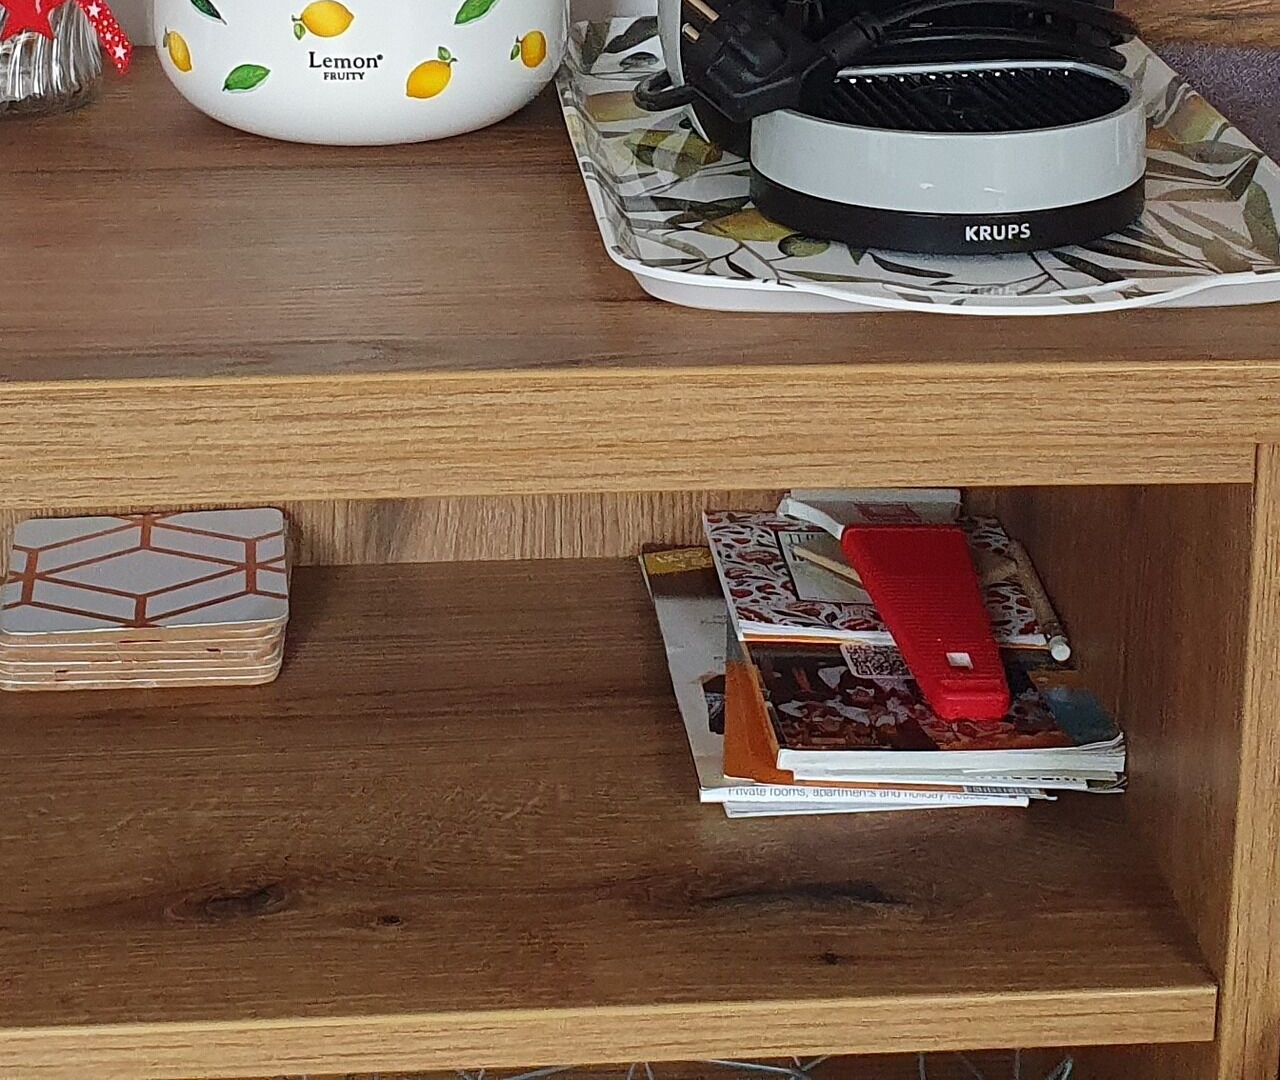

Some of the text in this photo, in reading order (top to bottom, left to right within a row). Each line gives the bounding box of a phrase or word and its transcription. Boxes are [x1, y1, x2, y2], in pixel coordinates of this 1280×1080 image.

[308, 51, 379, 69] Lemon
[323, 71, 366, 81] FRUITY
[965, 223, 1031, 241] KRUPS
